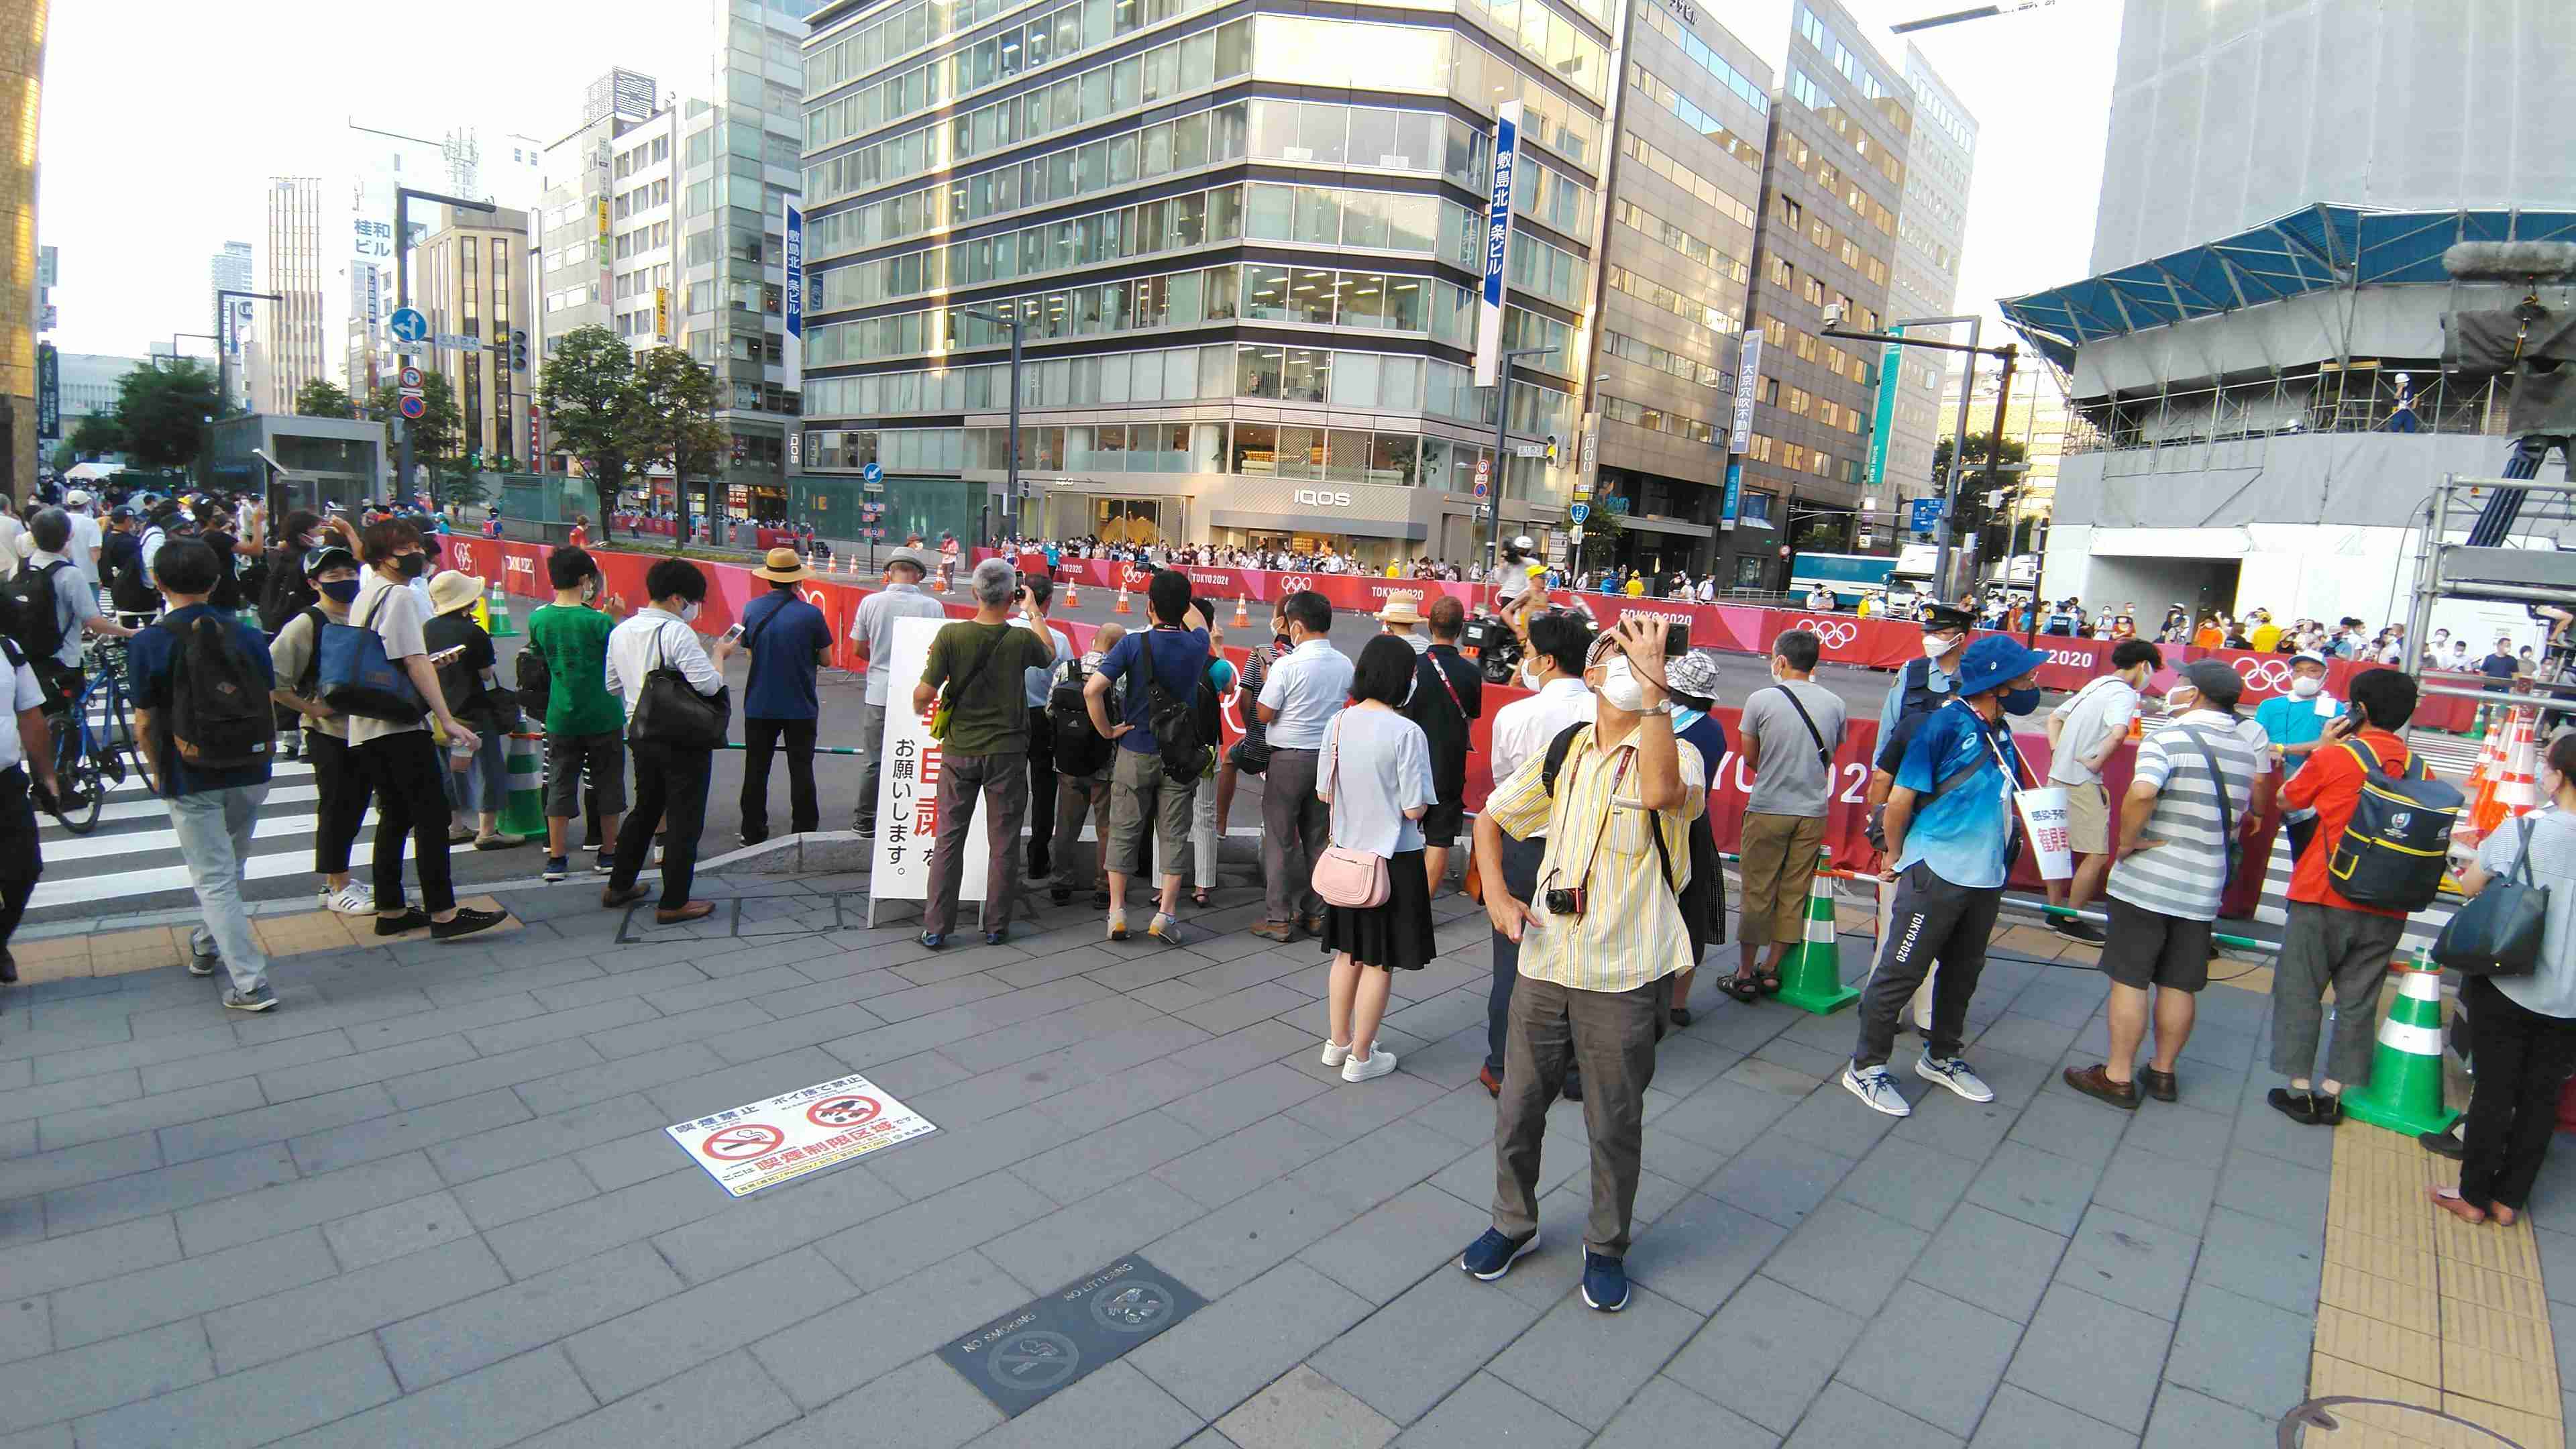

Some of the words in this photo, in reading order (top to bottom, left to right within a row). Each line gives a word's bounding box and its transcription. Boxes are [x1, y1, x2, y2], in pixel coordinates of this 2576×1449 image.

[1487, 149, 1512, 276] 敷島北一条ビル
[354, 219, 390, 239] 桂和
[356, 239, 390, 257] ビル
[788, 229, 800, 314] 敷島北一条ビル
[1735, 364, 1755, 443] 大京穴吹不動産
[790, 433, 798, 464] IQOS
[1294, 489, 1351, 506] IQOS
[1192, 573, 1212, 584] TOKYO
[2046, 649, 2092, 667] 2020
[887, 737, 916, 877] お願いします。
[1906, 912, 1925, 941] TOKYO
[1896, 939, 1913, 962] 2020
[1063, 1288, 1081, 1301] NO
[961, 1339, 983, 1354] NO
[983, 1311, 1037, 1342] SMOKING
